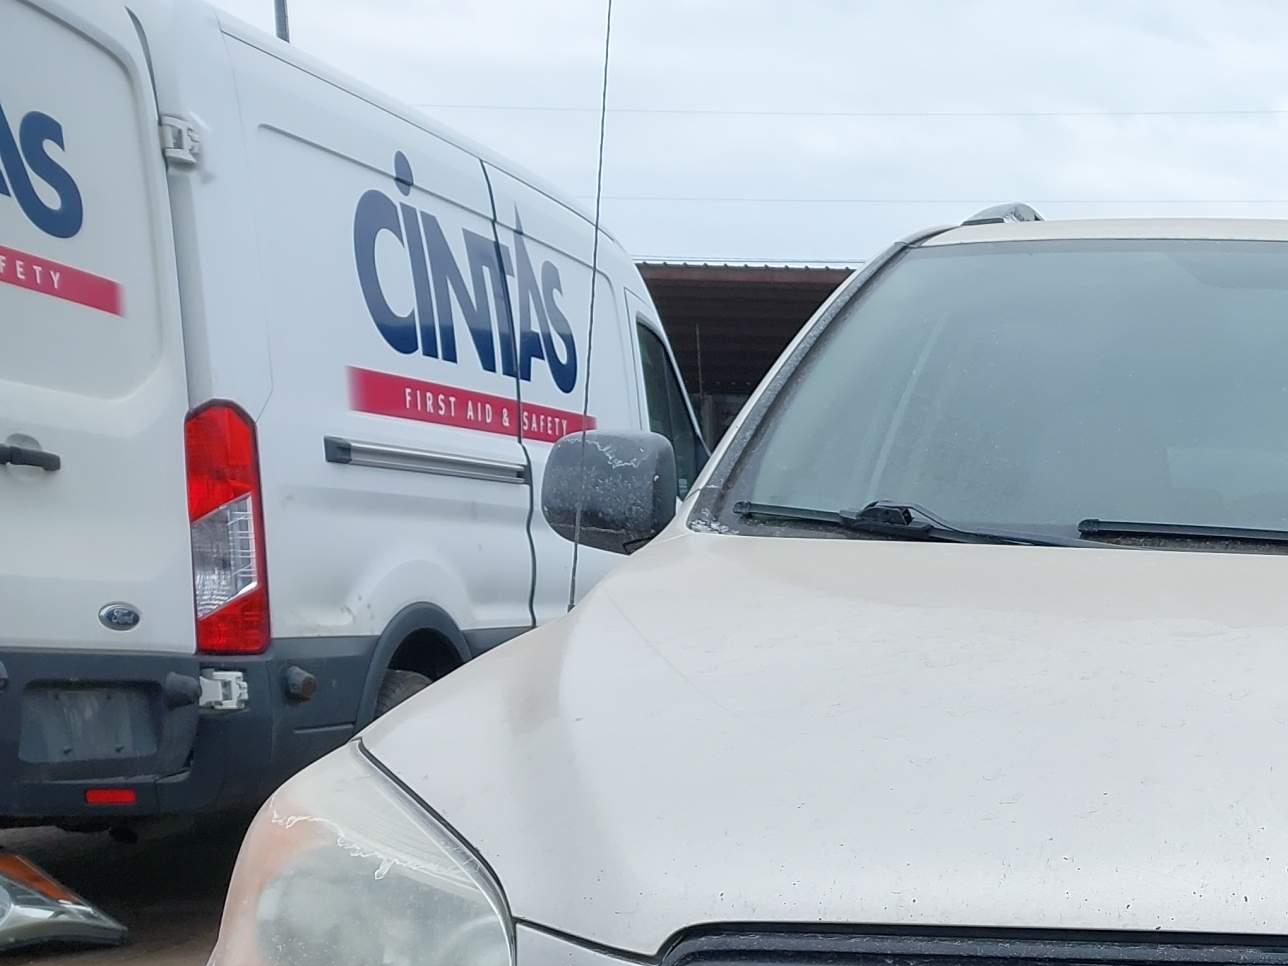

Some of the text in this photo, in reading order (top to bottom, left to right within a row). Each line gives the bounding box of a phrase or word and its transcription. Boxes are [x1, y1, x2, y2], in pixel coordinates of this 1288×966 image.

[353, 150, 578, 394] CINTAS
[404, 386, 568, 436] FIRST AID & SAFETY
